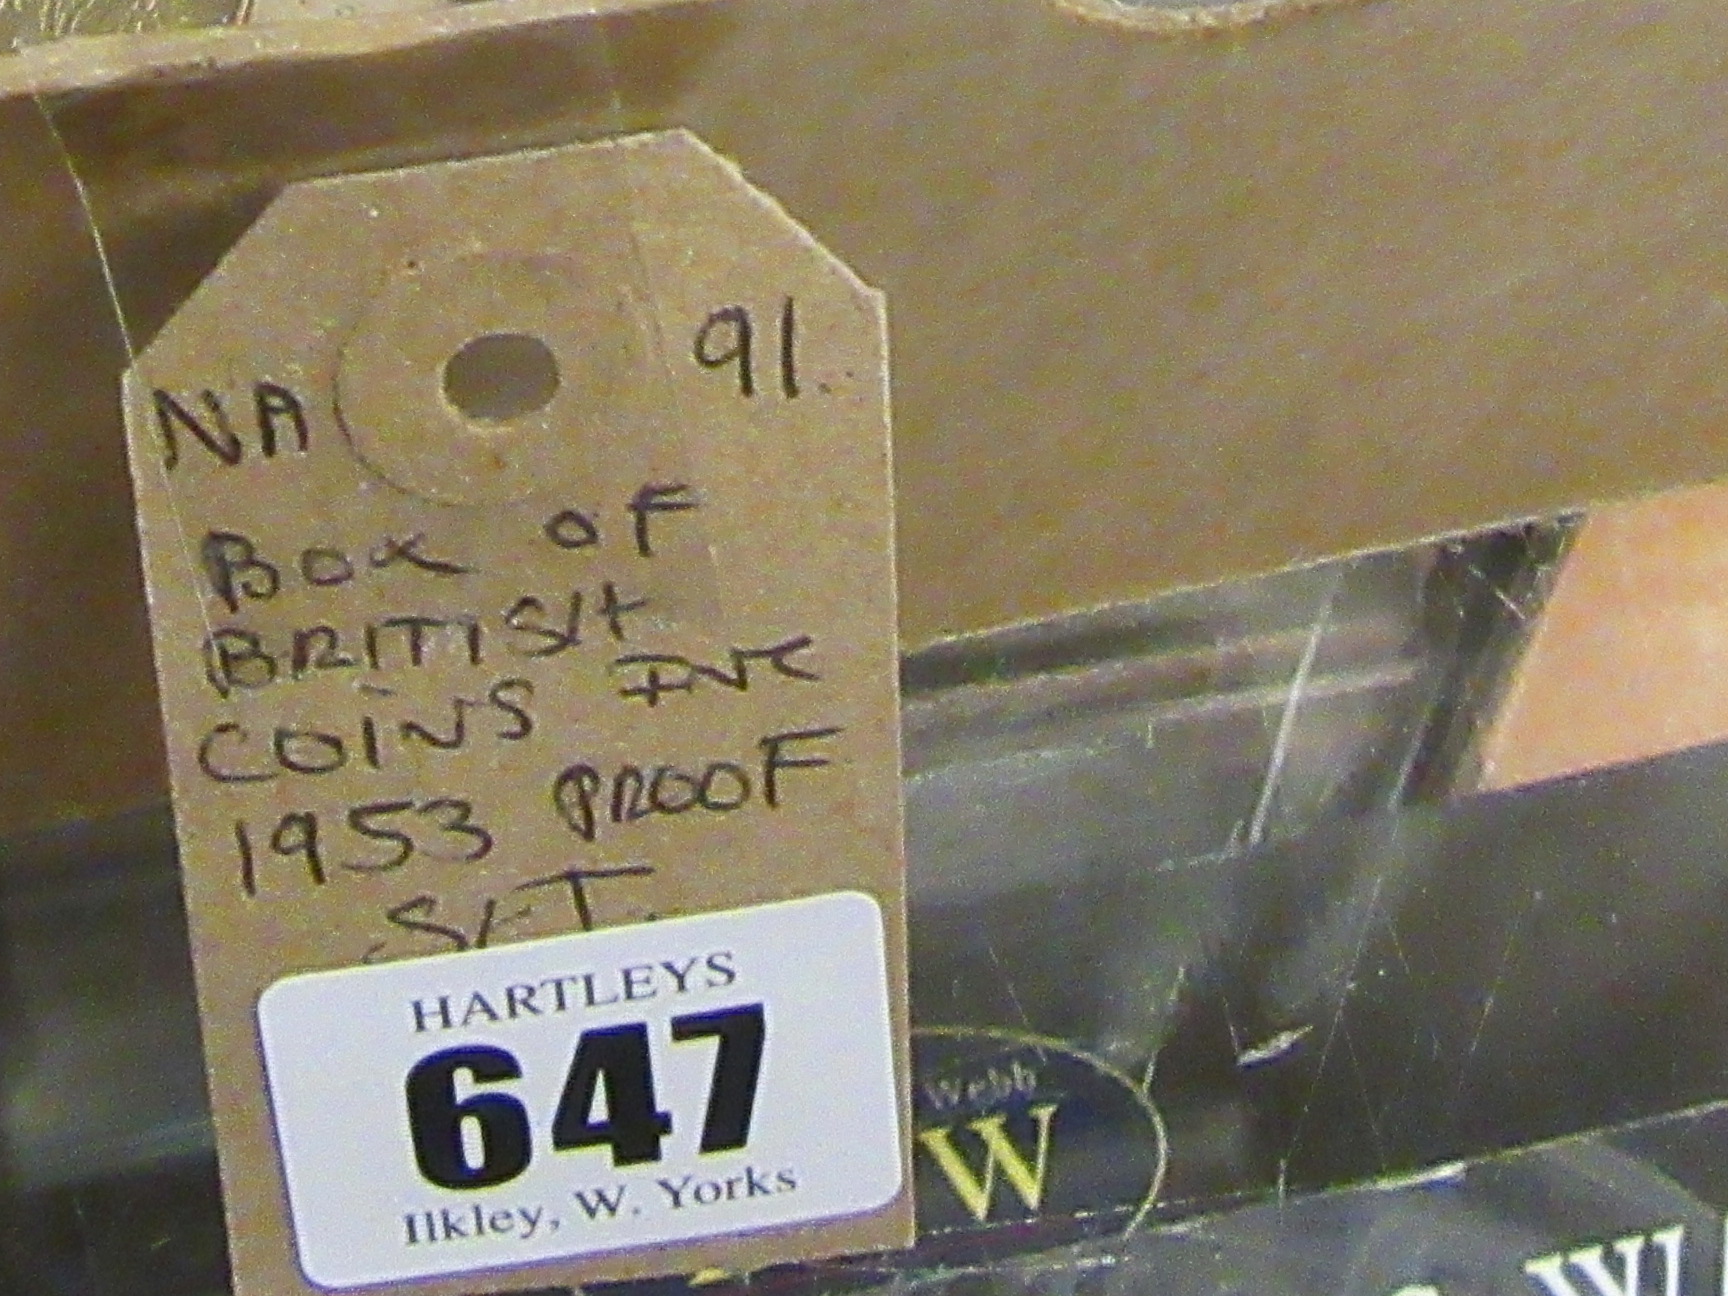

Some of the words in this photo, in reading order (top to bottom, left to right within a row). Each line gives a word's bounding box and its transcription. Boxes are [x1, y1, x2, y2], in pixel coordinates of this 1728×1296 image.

[152, 379, 311, 472] NA
[202, 530, 474, 612] BOX
[544, 482, 706, 557] OF
[196, 676, 536, 784] COINS
[234, 794, 497, 898] 1953
[551, 725, 847, 842] PROOF
[408, 947, 742, 1036] HARTLEYS
[402, 1001, 769, 1195] 647
[922, 1059, 1038, 1111] Webb
[402, 1193, 567, 1250] Ilkley,
[576, 1182, 642, 1225] W.
[654, 1162, 799, 1214] Yorks
